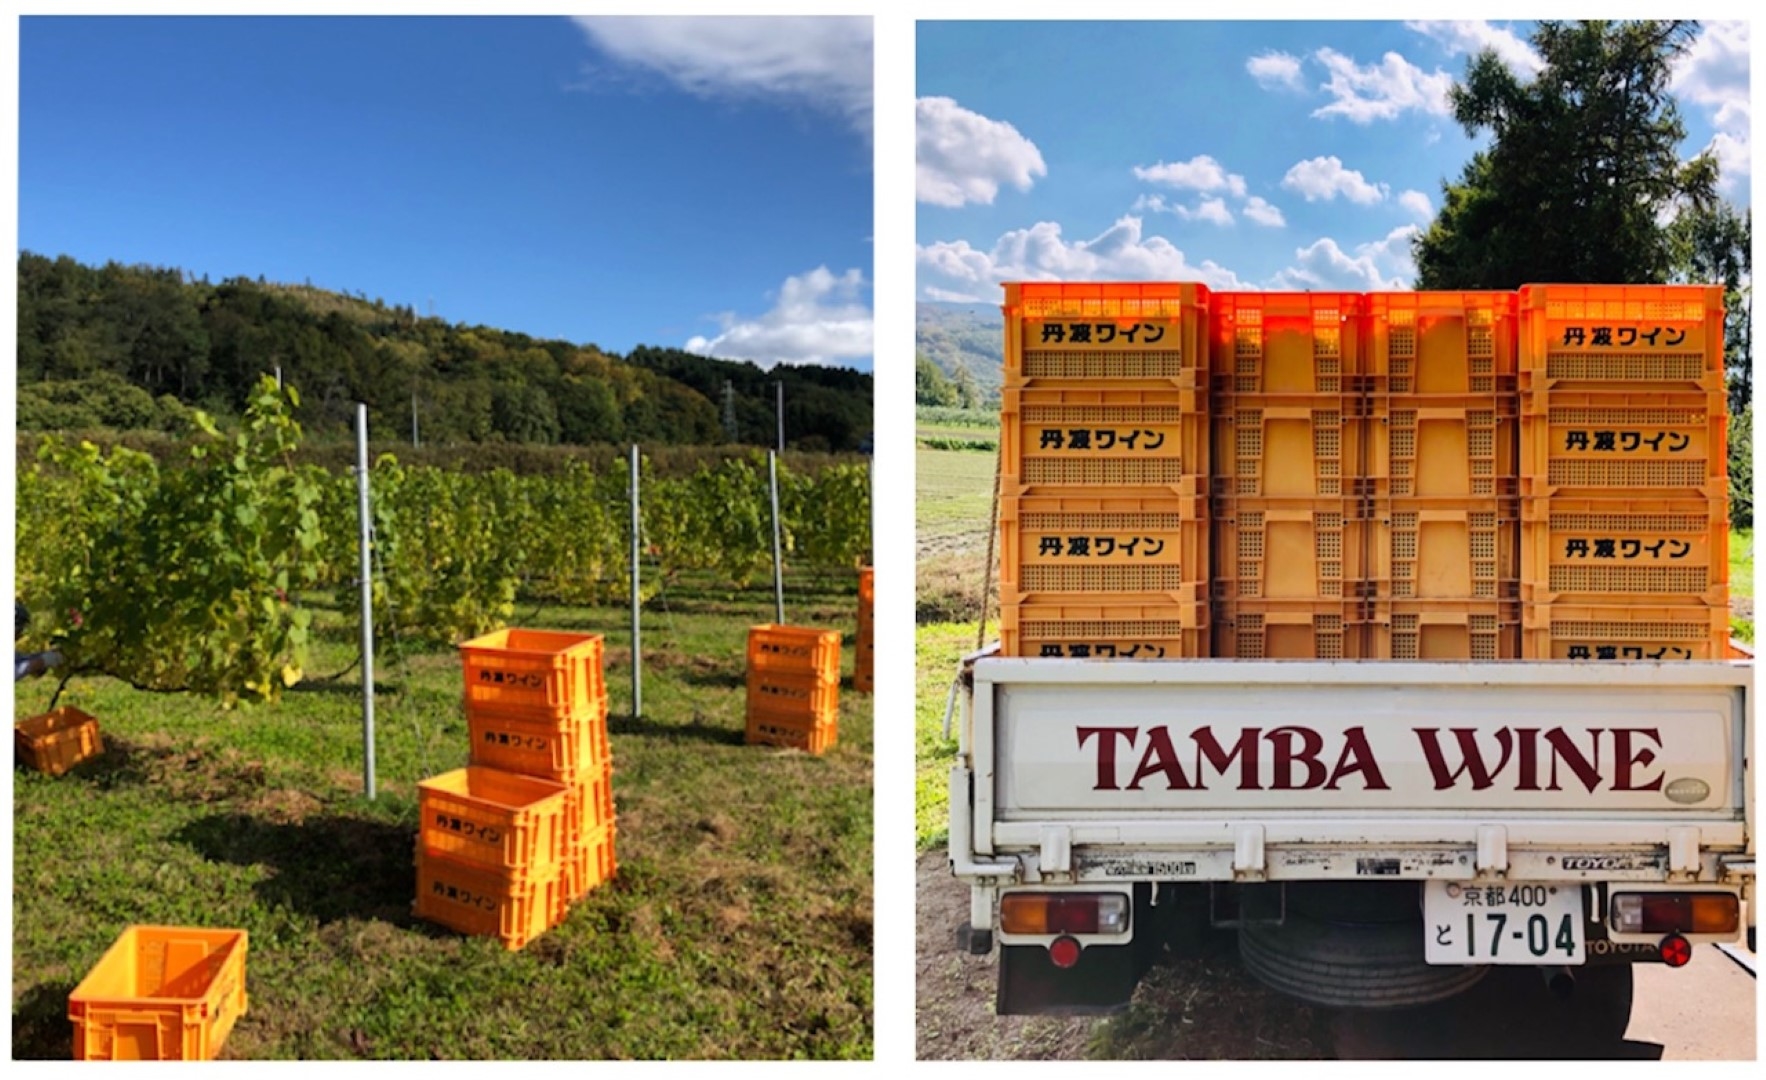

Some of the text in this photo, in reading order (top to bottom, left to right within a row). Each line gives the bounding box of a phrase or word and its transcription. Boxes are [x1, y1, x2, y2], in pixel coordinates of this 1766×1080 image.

[1041, 323, 1164, 343] 丹波ワイン
[1563, 326, 1686, 346] 丹波ワイン
[1040, 429, 1164, 449] 丹波ワイン
[1565, 431, 1690, 452] 丹波ワイン
[1039, 536, 1164, 556] 丹波ワイン
[1566, 539, 1690, 558] 丹波ワイン
[1076, 725, 1666, 795] TAMBA WINE
[1563, 857, 1633, 870] TOYO
[1436, 913, 1576, 957] と 17-04
